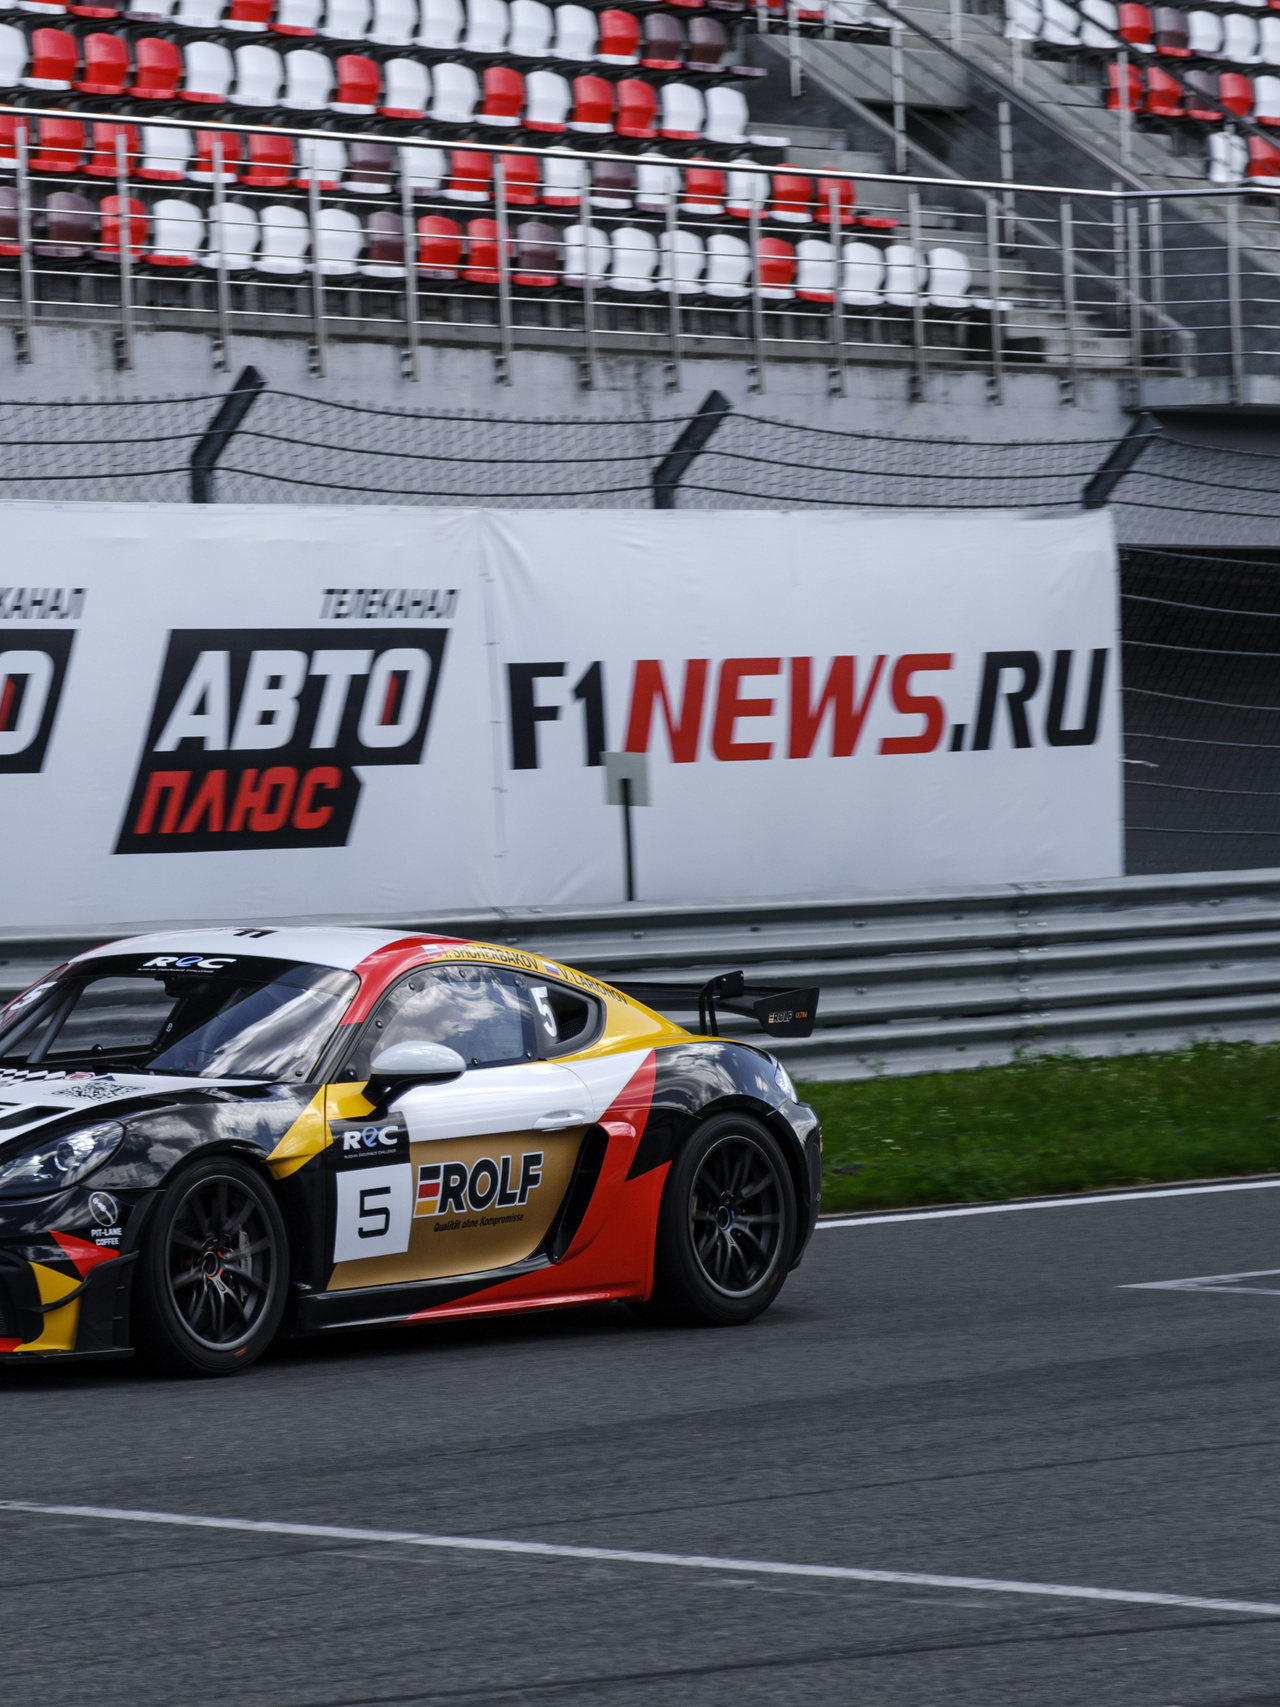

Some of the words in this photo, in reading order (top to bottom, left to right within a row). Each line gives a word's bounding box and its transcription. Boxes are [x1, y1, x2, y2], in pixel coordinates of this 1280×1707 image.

[319, 588, 461, 620] ТЕЛЕКАНАЛ
[153, 647, 432, 752] АВТО
[506, 647, 1111, 770] F1NEWS.RU
[133, 765, 342, 835] ПЛЮС
[530, 986, 558, 1037] 5
[437, 1151, 544, 1214] ROLF
[91, 1227, 122, 1237] PIT-LANE
[357, 1186, 391, 1239] 5
[462, 1218, 479, 1229] ohne
[480, 1213, 524, 1227] Kompromisse
[95, 1237, 119, 1246] COFFEE
